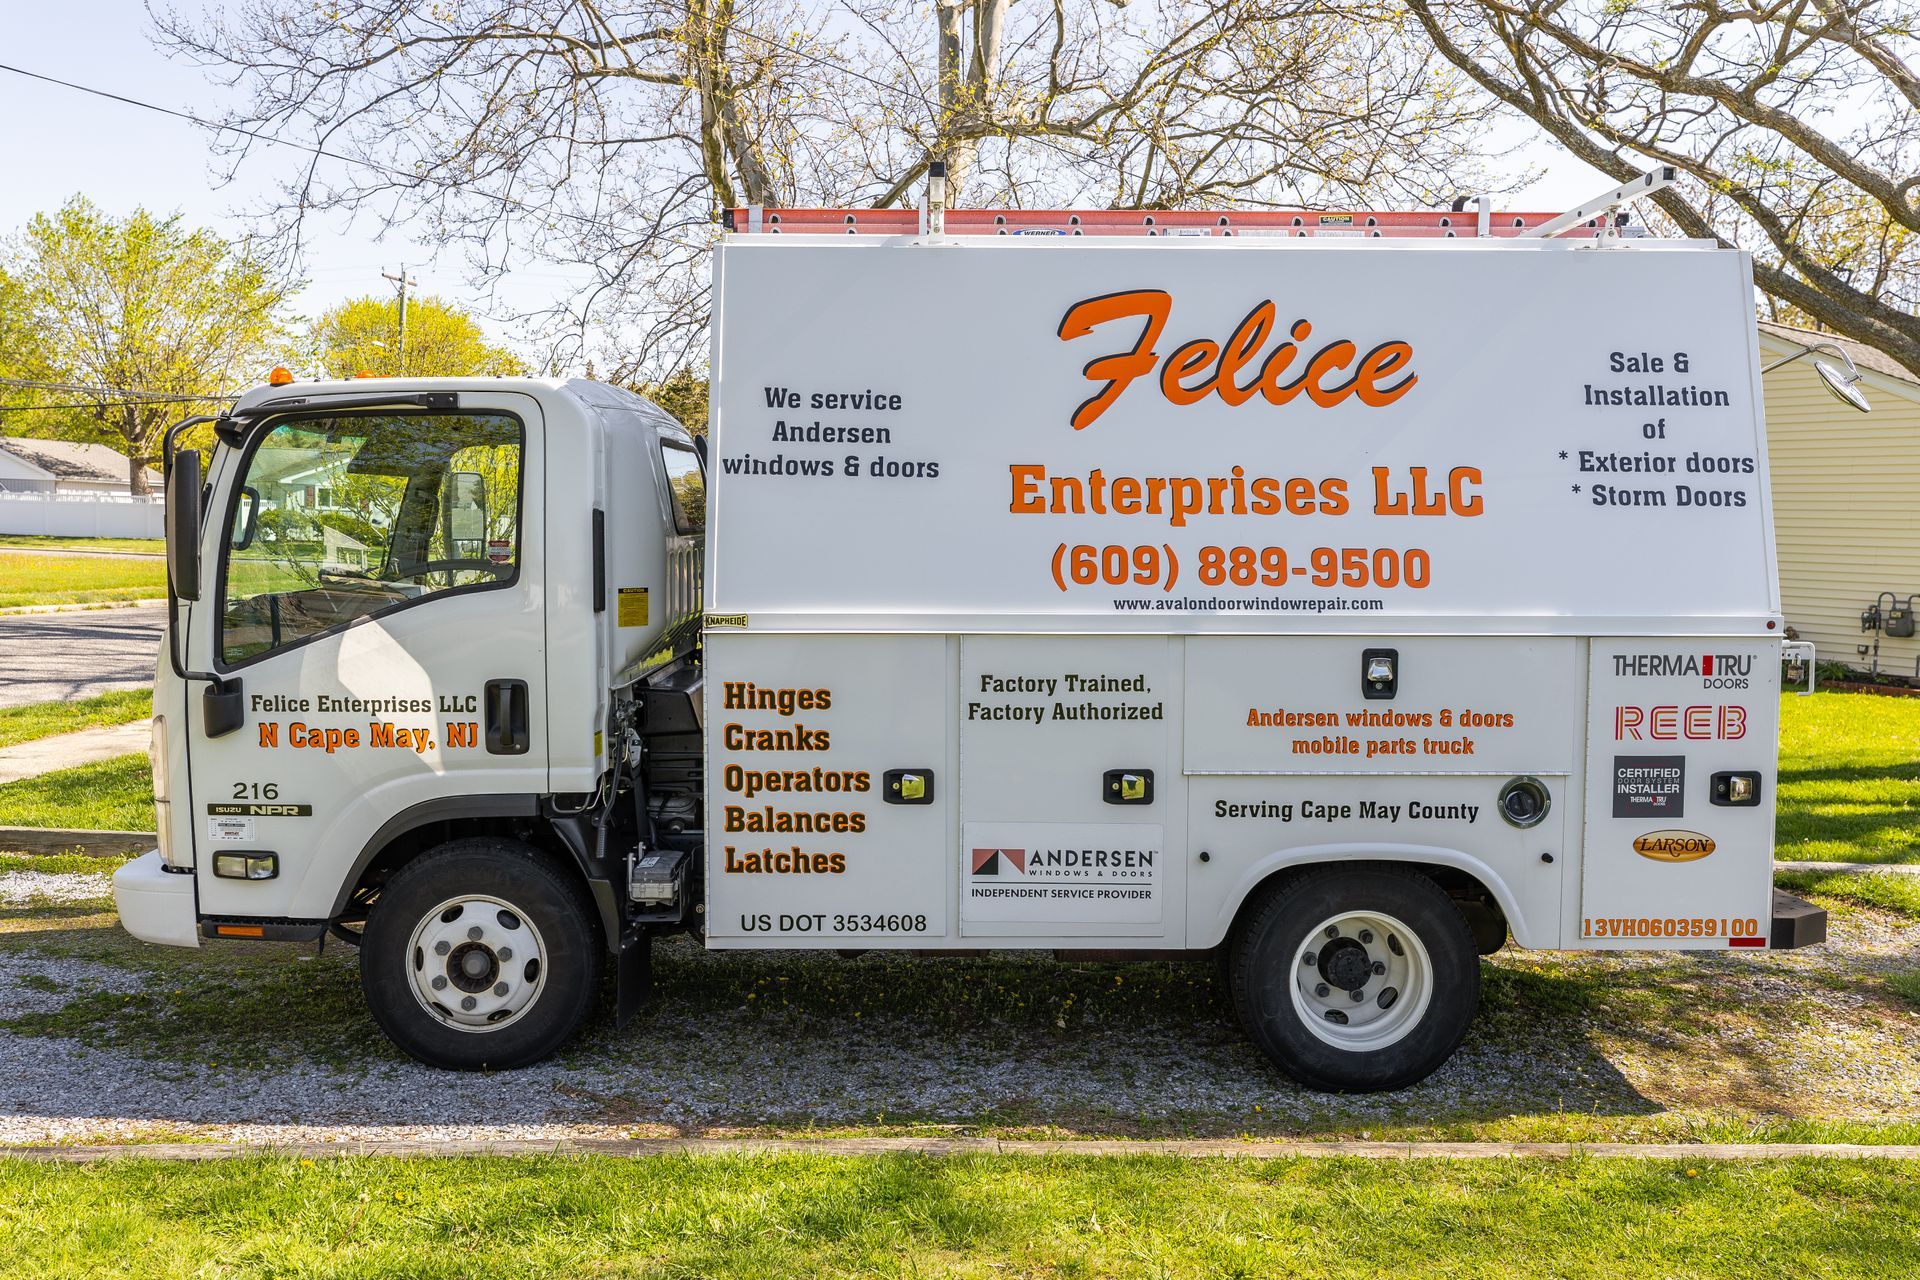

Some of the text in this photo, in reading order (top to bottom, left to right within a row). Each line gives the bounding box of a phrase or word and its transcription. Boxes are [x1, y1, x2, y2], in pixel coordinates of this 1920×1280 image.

[1057, 288, 1419, 431] Felice
[1609, 351, 1689, 373] Sale &
[764, 387, 902, 411] We service
[1584, 384, 1730, 406] Installation
[772, 420, 891, 443] Andersen
[1642, 418, 1666, 439] of
[722, 453, 940, 478] windows & doors
[1578, 451, 1755, 474] Exterior doors
[1009, 464, 1485, 527] Enterprises LLC
[1591, 484, 1747, 507] Storm Doors
[1050, 543, 1432, 593] (609) 889-9500
[1113, 597, 1385, 613] www.avalondoorwindowrepair.com
[705, 615, 746, 627] KNAPHEIDE
[1613, 655, 1700, 676] THERMA
[980, 674, 1151, 697] Factory Trained,
[1703, 678, 1749, 689] DOORS
[251, 694, 477, 717] Felice Enterprises LLC
[723, 681, 832, 716] Hinges
[968, 702, 1164, 725] Factory Authorized
[1246, 708, 1514, 728] Andersen windows & doors
[1615, 705, 1747, 741] REEB
[258, 721, 479, 754] N Cape May, NJ
[723, 722, 831, 751] Cranks
[1292, 736, 1475, 759] mobile parts truck
[723, 763, 871, 799] Operators
[1617, 768, 1681, 778] CERTIFIED
[232, 782, 279, 800] 216
[1617, 784, 1680, 794] INSTALLER
[250, 805, 299, 815] NPR
[723, 804, 866, 834] Balances
[1214, 800, 1480, 824] Serving Cape May County
[1029, 849, 1153, 867] ANDERSEN
[1640, 838, 1709, 857] LARSON
[724, 845, 847, 875] Latches
[1029, 869, 1090, 877] WINDOWS
[971, 888, 1152, 900] INDEPENDENT SERVICE PROVIDER
[740, 914, 927, 932] US DOT 3534608
[1584, 918, 1758, 937] 13VH060359100
